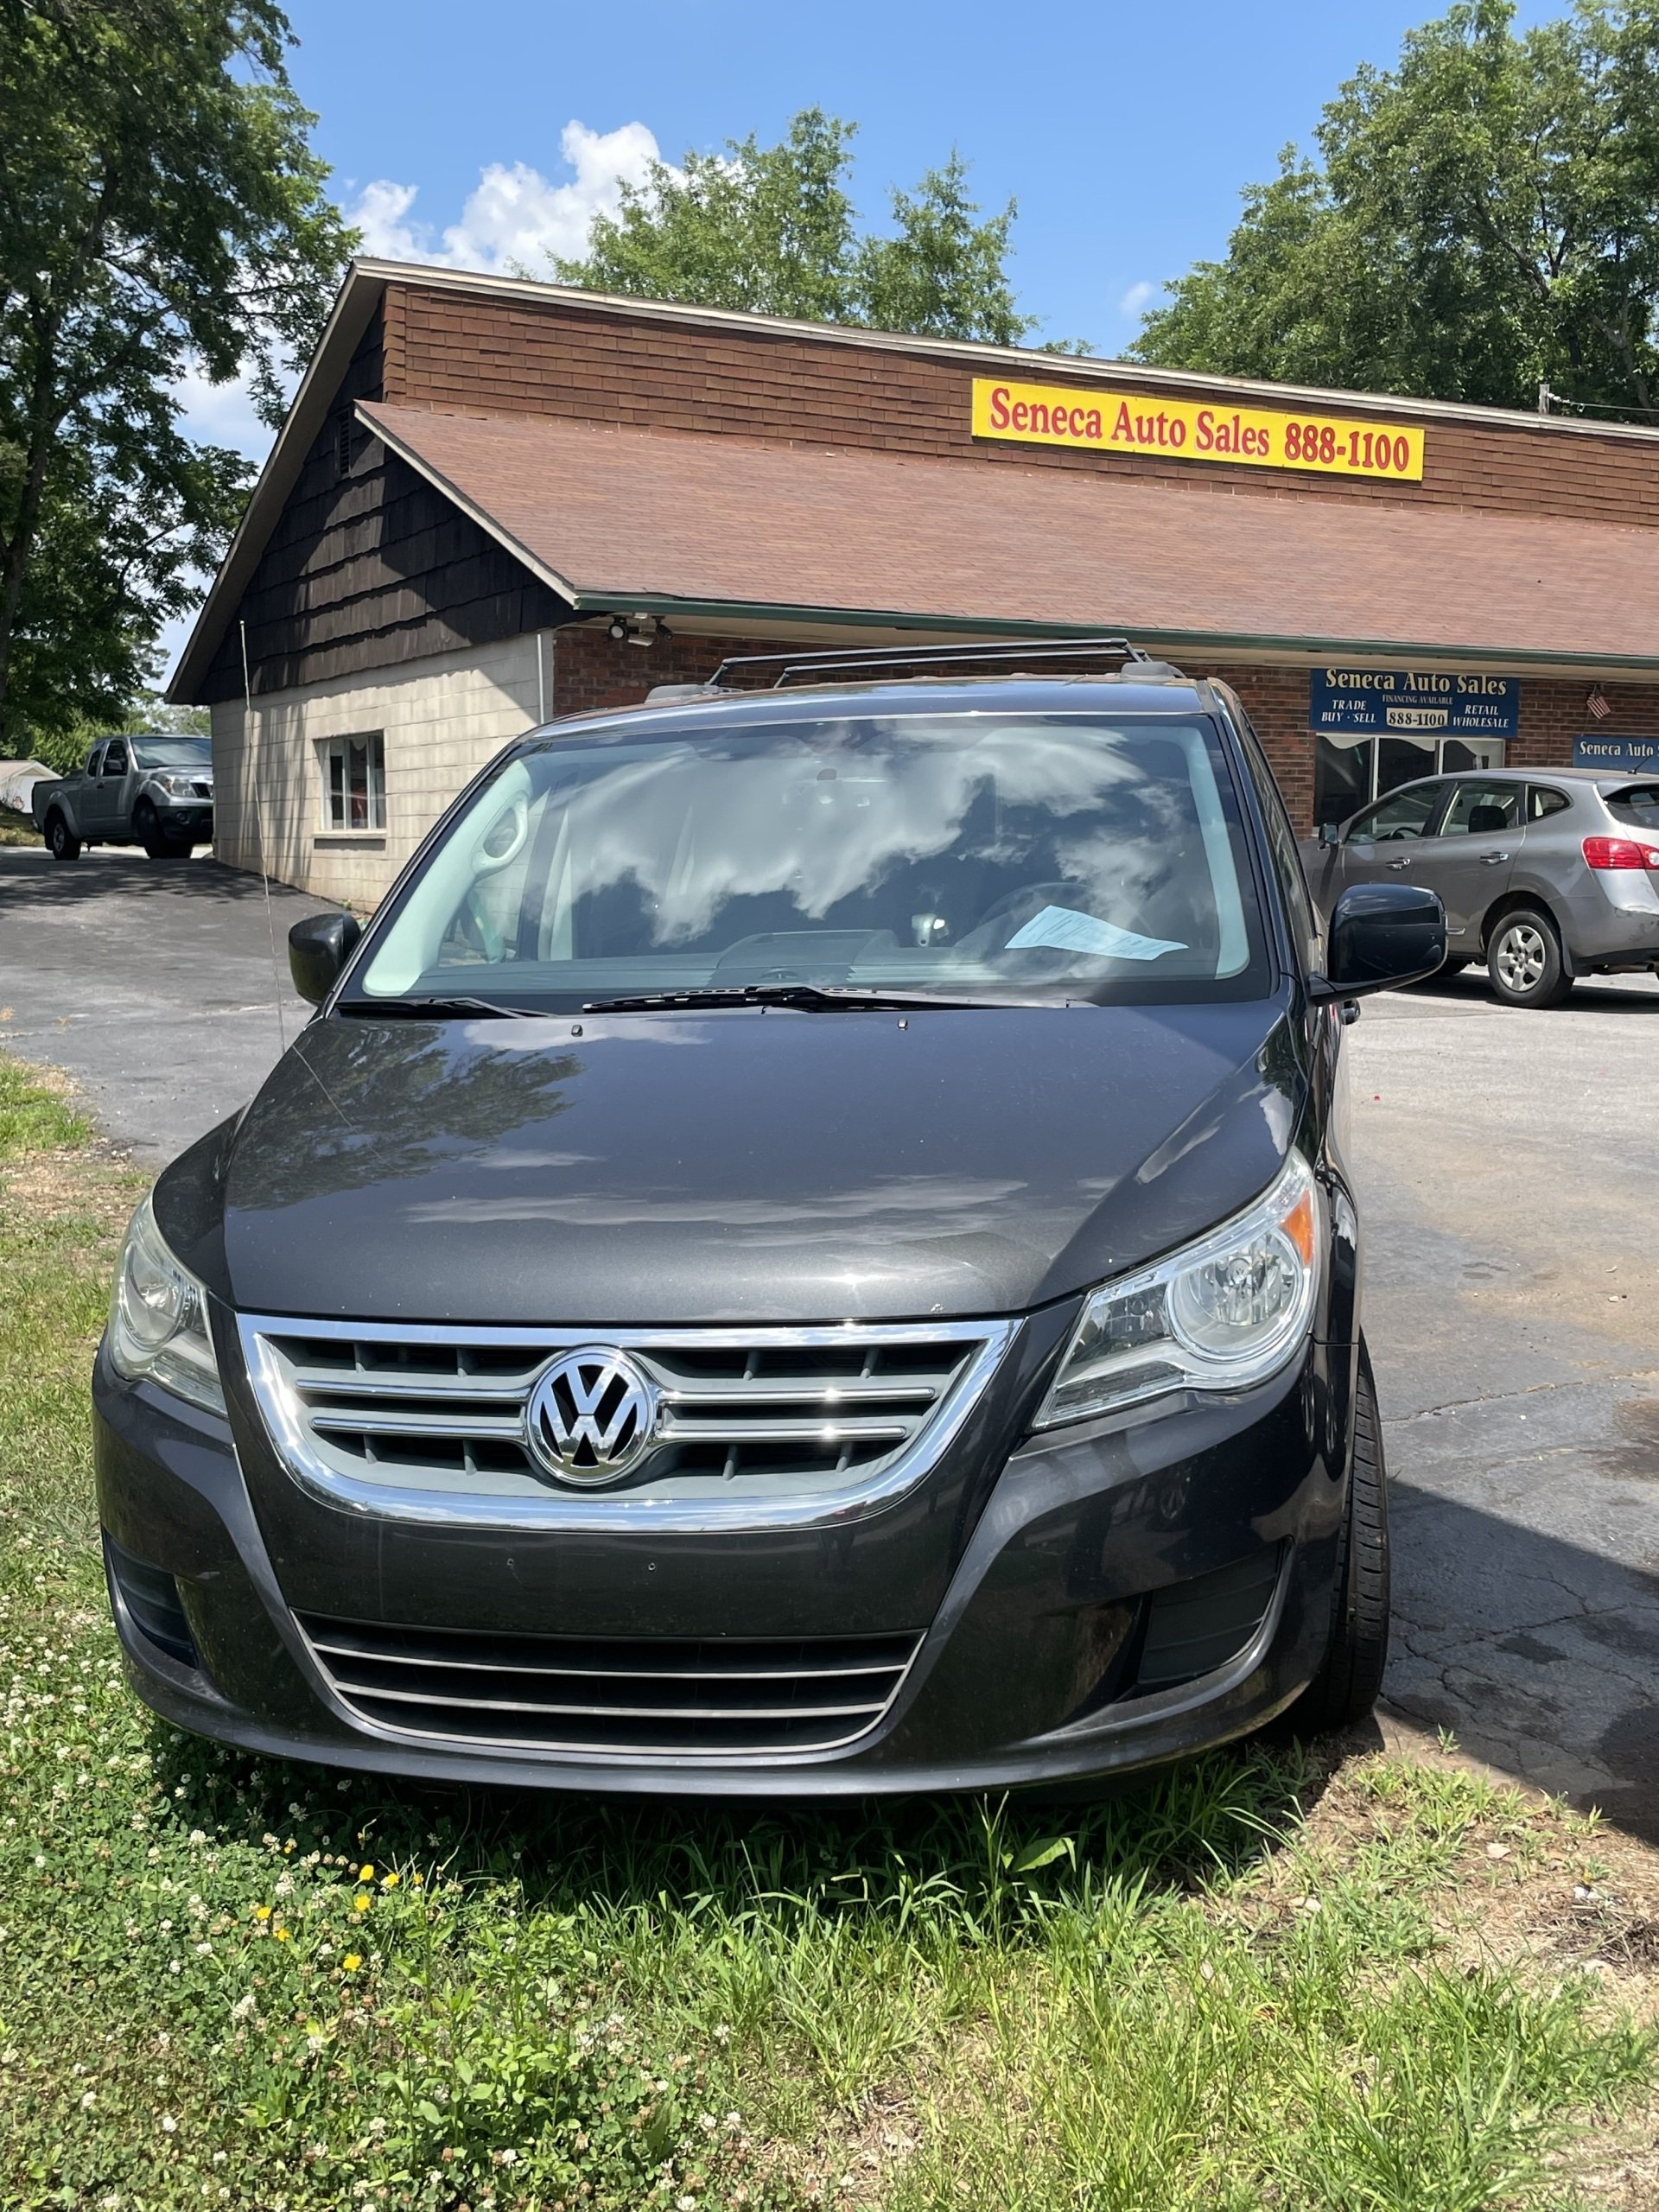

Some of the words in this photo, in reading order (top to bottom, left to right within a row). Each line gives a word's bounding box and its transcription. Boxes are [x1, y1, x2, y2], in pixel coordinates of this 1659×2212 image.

[990, 387, 1103, 440] Seneca
[1110, 401, 1186, 448] Auto
[1196, 410, 1270, 457] Sales
[1284, 423, 1409, 472] 888-1100
[1325, 668, 1395, 690] Seneca
[1402, 672, 1451, 692] Auto
[1457, 675, 1507, 696] Sales
[1332, 699, 1367, 710] TRADE
[1382, 694, 1417, 704] FINANCING
[1418, 696, 1453, 705] AVAILABLE
[1465, 704, 1499, 715] RETAIL
[1321, 711, 1344, 722] BUY
[1353, 713, 1376, 723] SELL
[1389, 712, 1446, 726] 888-1100
[1452, 716, 1510, 728] WHOLESALE
[1580, 741, 1621, 756] Seneca
[1625, 742, 1654, 757] Auto
[532, 1351, 646, 1478] VW
